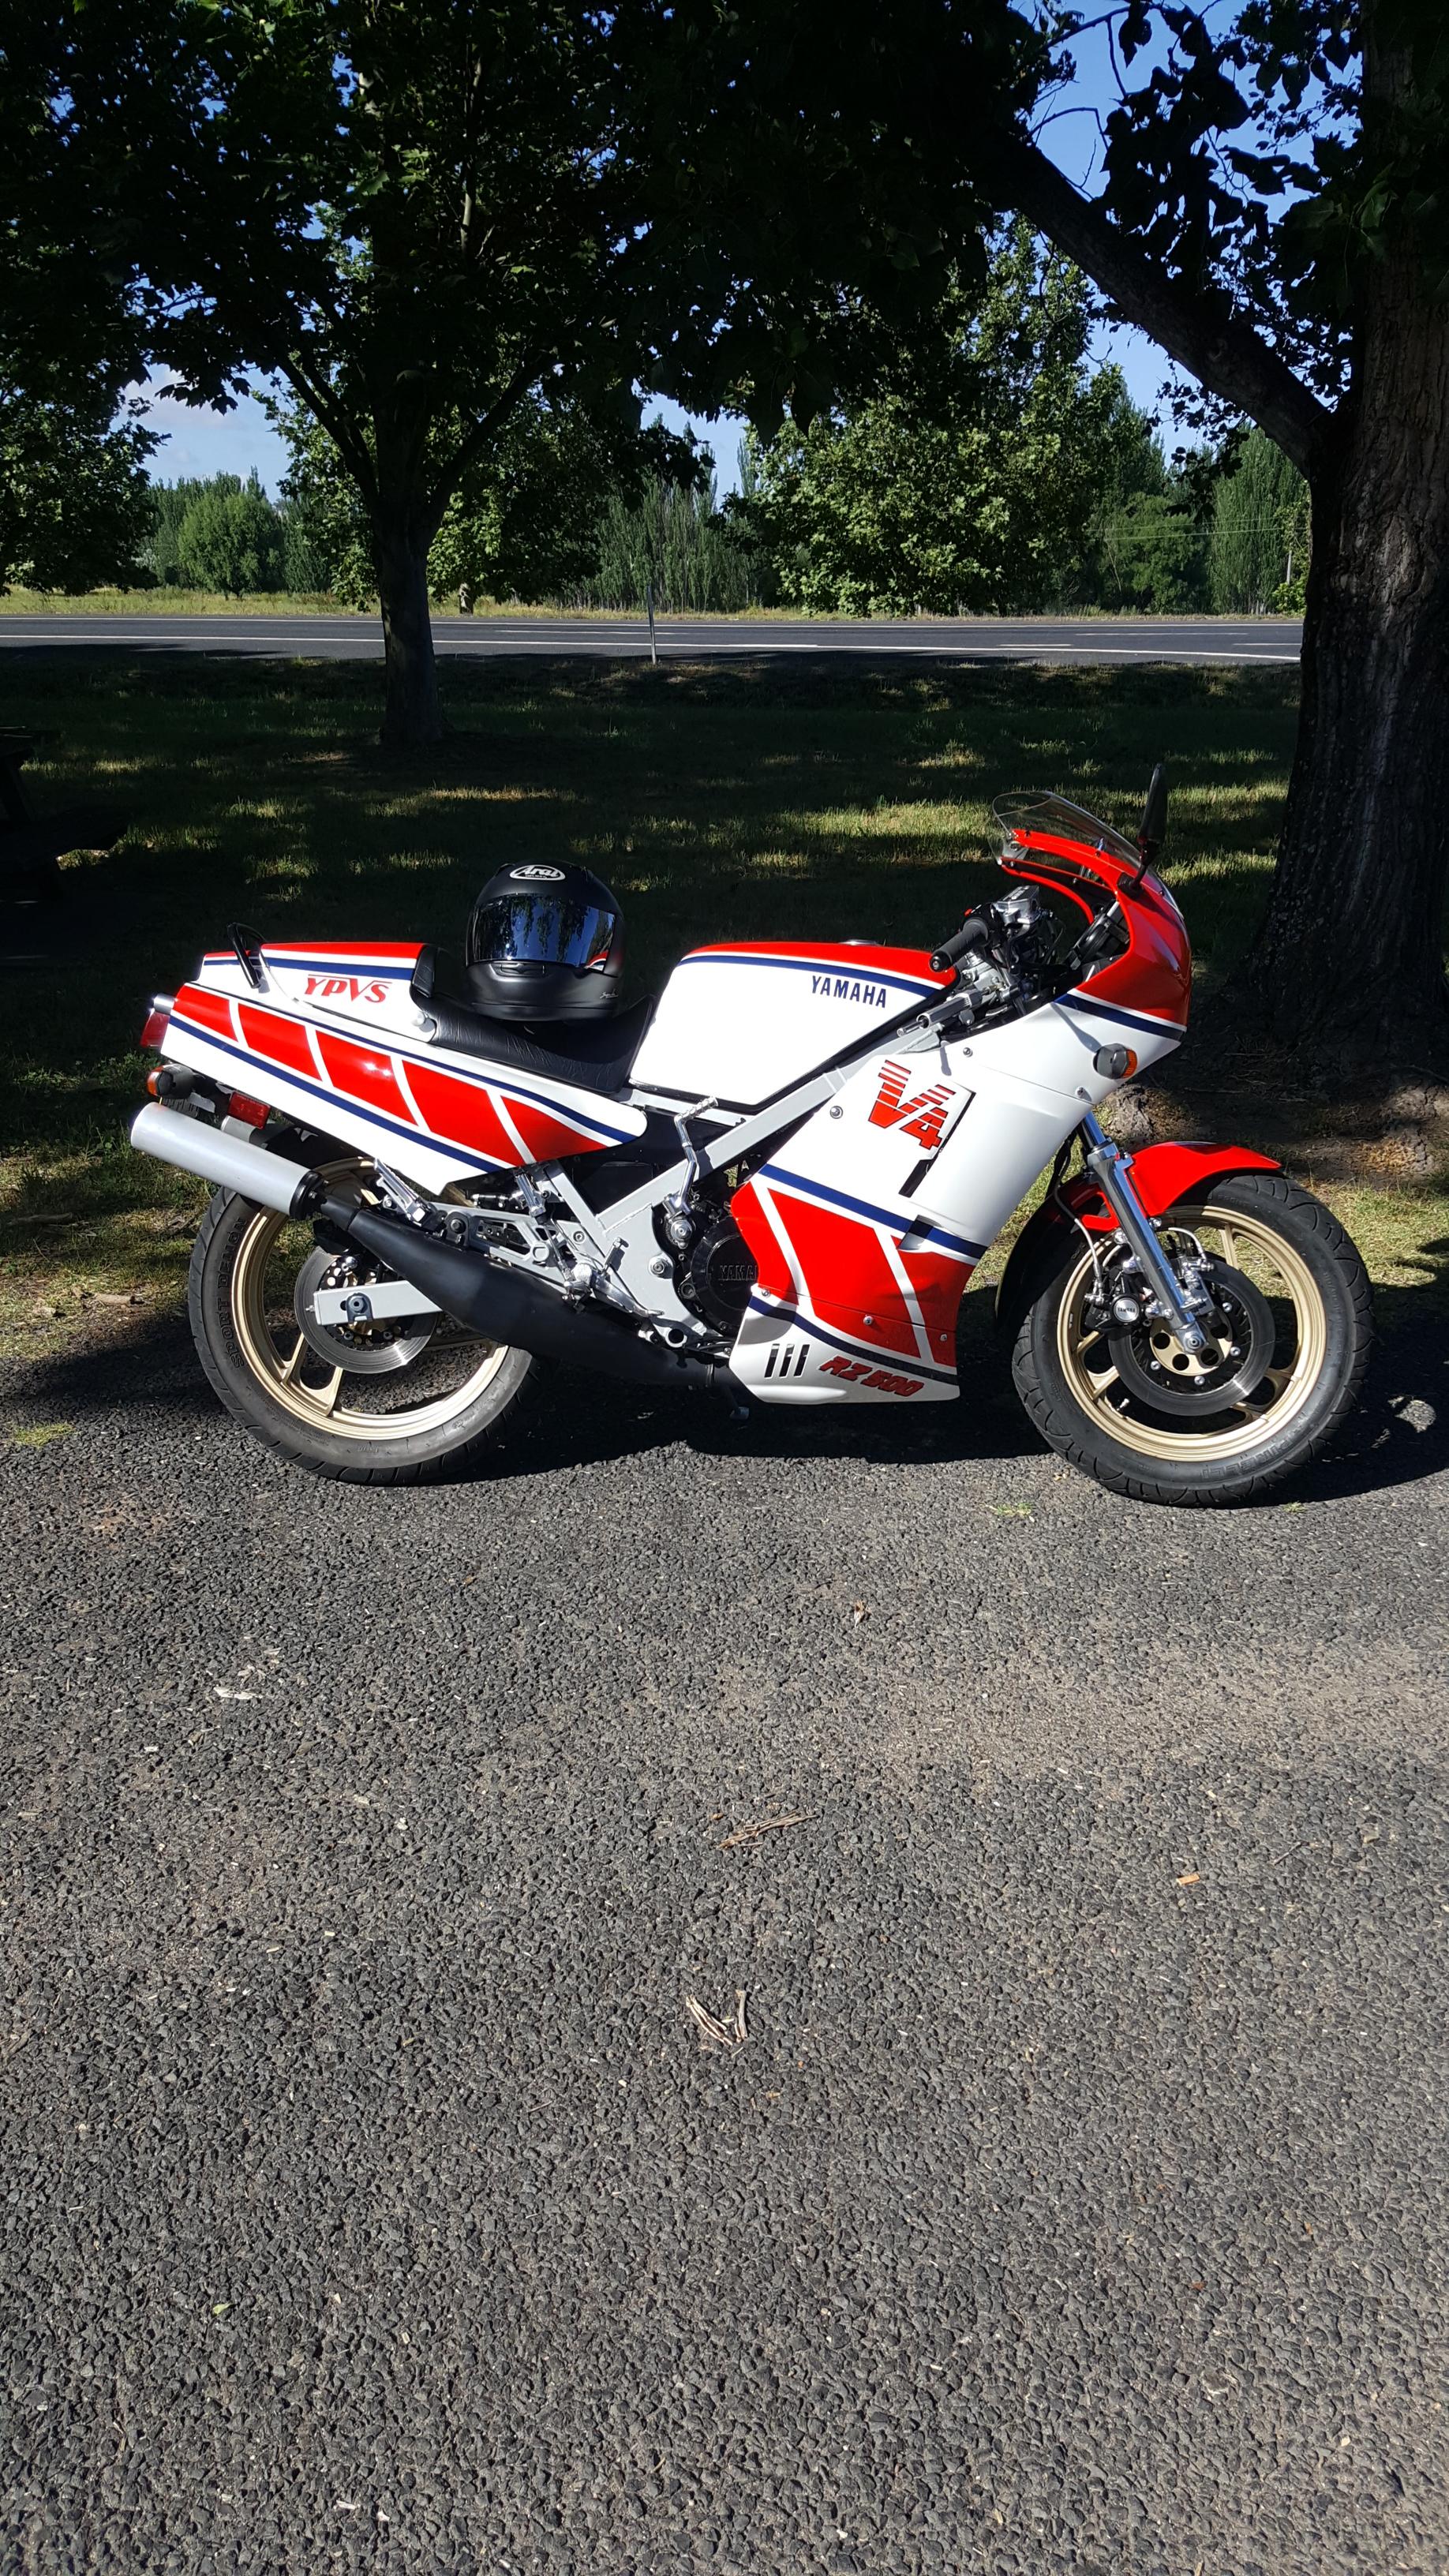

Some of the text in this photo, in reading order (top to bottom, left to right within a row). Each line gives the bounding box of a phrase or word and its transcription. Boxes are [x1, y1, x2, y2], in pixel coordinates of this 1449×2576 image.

[514, 865, 559, 878] Arai
[304, 974, 392, 1003] YPVS
[812, 975, 886, 1009] YAMAHA
[868, 1059, 957, 1150] V4
[217, 1218, 247, 1369] SPORT DEMON
